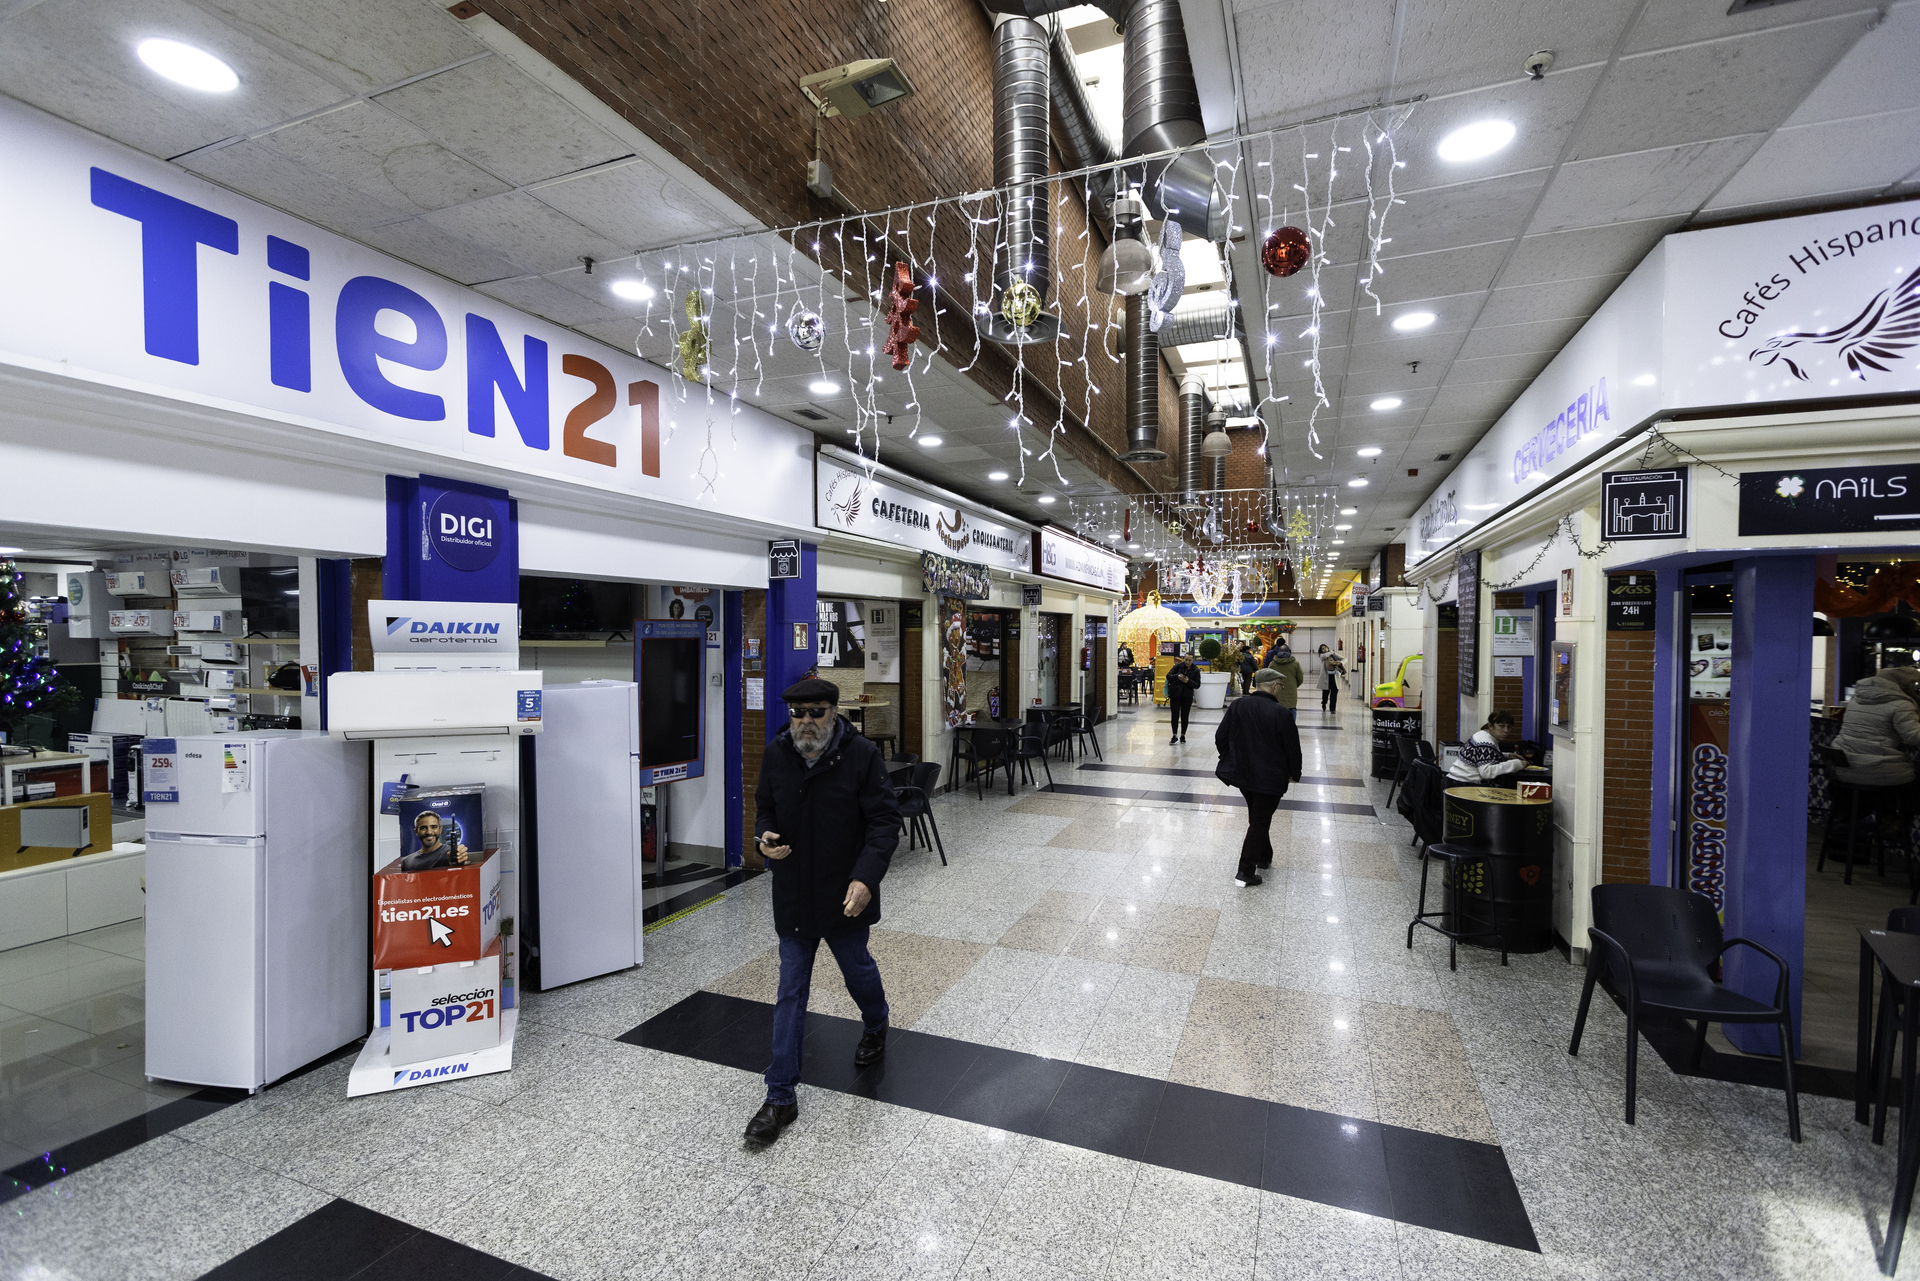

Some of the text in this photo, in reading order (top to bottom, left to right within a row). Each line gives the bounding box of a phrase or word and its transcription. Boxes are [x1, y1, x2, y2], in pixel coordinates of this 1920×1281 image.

[1718, 273, 1791, 339] Cafés
[1513, 376, 1610, 485] CERVECERIA
[872, 497, 930, 531] CAFETERIA
[440, 513, 492, 539] DIGI
[440, 535, 492, 547] Distribuidor oficial
[972, 528, 1014, 554] CROISSANTERIE
[180, 551, 189, 560] LG
[1625, 585, 1651, 594] GSS
[872, 610, 884, 623] H
[1622, 606, 1640, 615] 24H
[174, 616, 185, 627] 479
[410, 622, 500, 634] DAIKIN
[1497, 617, 1515, 633] H
[409, 636, 497, 644] aerotermia
[816, 632, 841, 660] EZA
[525, 698, 534, 708] 5
[1377, 718, 1401, 728] Galicia
[152, 758, 173, 768] 259€
[1694, 745, 1727, 819] SHOP
[377, 897, 413, 906] Especialistas
[421, 893, 473, 903] electrodomésticos
[381, 905, 469, 923] tien21.es
[431, 988, 494, 1007] selección
[400, 998, 494, 1033] TOP21
[409, 1062, 469, 1081] DAIKIN
